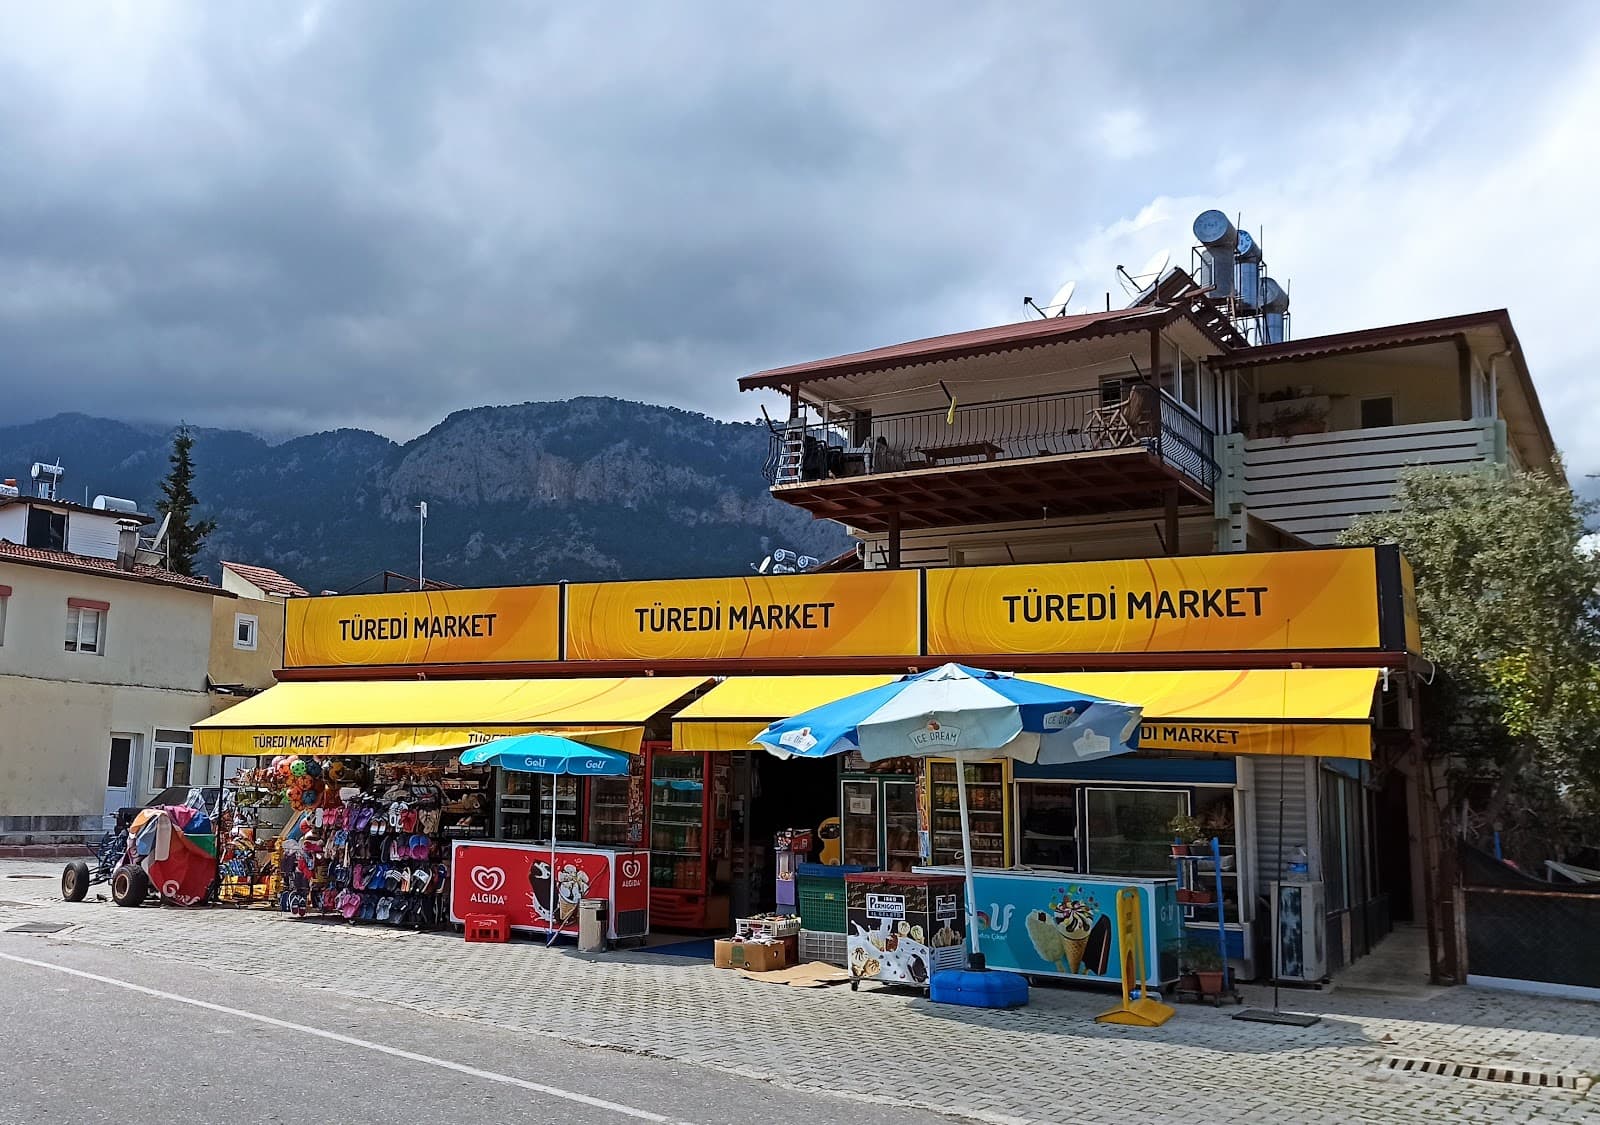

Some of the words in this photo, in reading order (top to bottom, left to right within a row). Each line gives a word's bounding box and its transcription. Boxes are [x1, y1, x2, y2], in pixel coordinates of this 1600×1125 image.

[1003, 585, 1116, 623] TÜREDİ
[1127, 587, 1268, 619] MARKET
[635, 600, 720, 632] TÜREDİ
[729, 603, 834, 630] MARKET
[339, 612, 407, 640] TÜREDİ
[414, 614, 496, 639] MARKET
[289, 735, 332, 748] MARKET
[914, 733, 926, 745] ICE
[929, 731, 957, 743] DREAM
[1163, 727, 1239, 745] MARKET
[524, 757, 547, 768] Golf
[585, 759, 606, 769] Golf
[470, 892, 505, 905] ALGIDA
